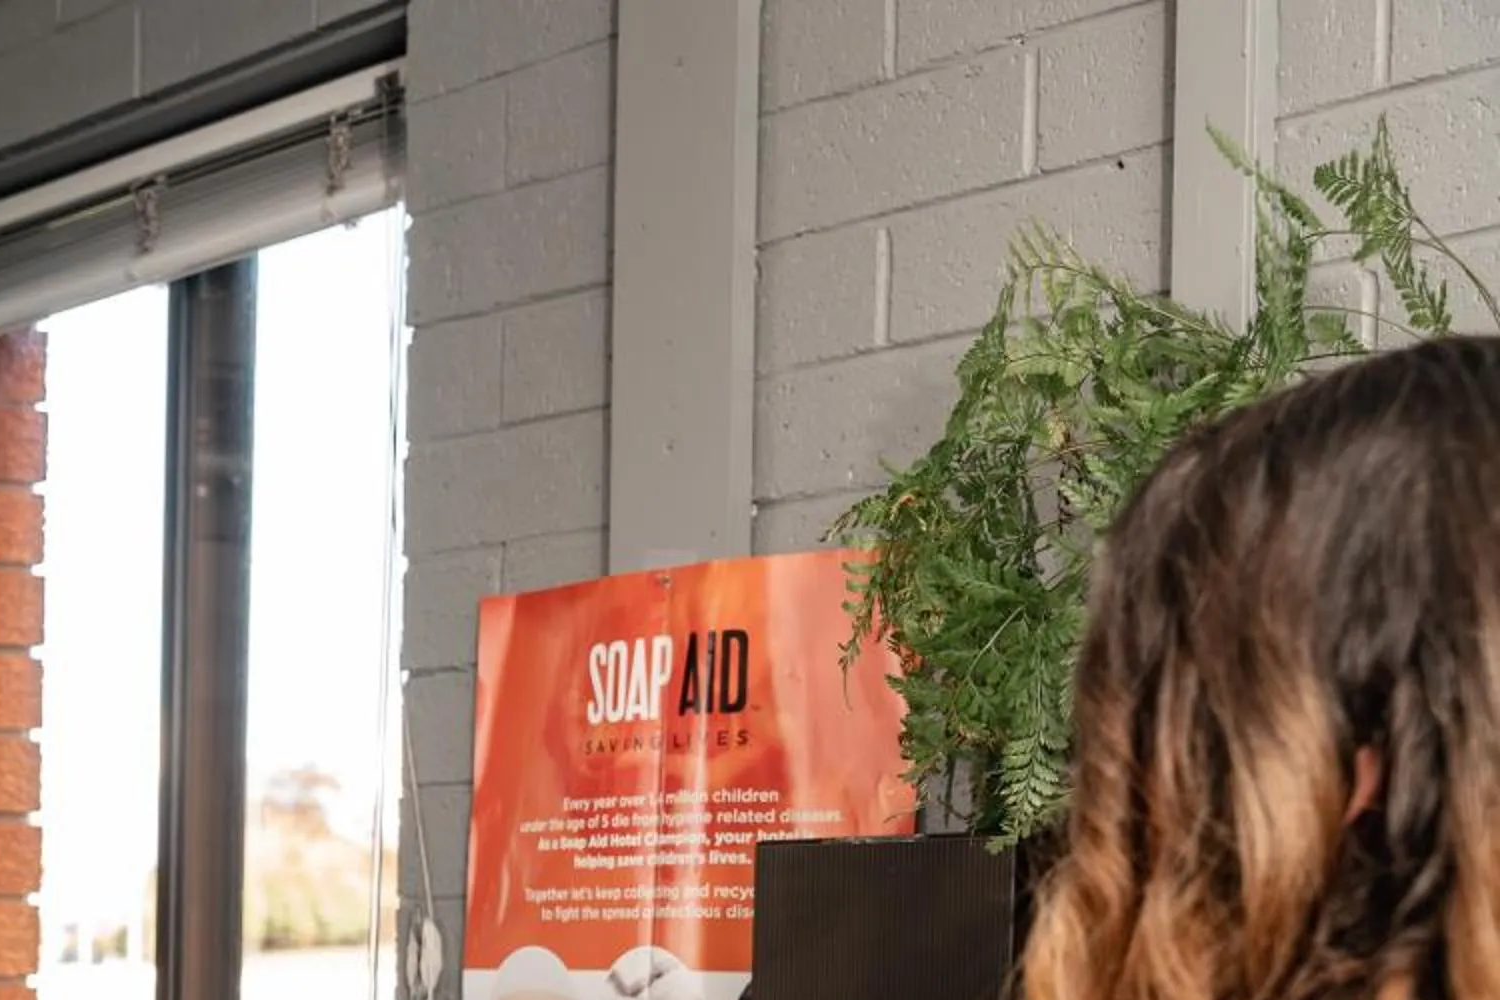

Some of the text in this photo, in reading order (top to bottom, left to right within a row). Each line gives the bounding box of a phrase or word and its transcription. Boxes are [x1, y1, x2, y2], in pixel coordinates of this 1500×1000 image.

[587, 634, 673, 725] SOAP
[585, 729, 749, 755] SAVING LIES
[563, 796, 589, 811] Every
[592, 796, 618, 810] year
[619, 795, 646, 807] over
[665, 789, 708, 805] million
[712, 787, 779, 803] children
[566, 819, 585, 833] age
[587, 814, 600, 828] of
[601, 814, 610, 829] 5
[611, 814, 630, 828] die
[632, 813, 658, 827] from
[717, 808, 775, 824] related
[537, 837, 551, 851] As
[560, 837, 588, 851] Soap
[588, 833, 608, 848] Aid
[610, 832, 641, 847] Hotel
[714, 831, 756, 847] your
[573, 855, 615, 870] helping
[617, 855, 644, 868] save
[709, 849, 753, 865] lives.
[525, 888, 569, 904] Together
[595, 885, 622, 901] keep
[683, 883, 708, 898] and
[541, 907, 554, 921] to
[555, 906, 580, 922] fight
[581, 907, 599, 920] the
[601, 906, 639, 921] spread
